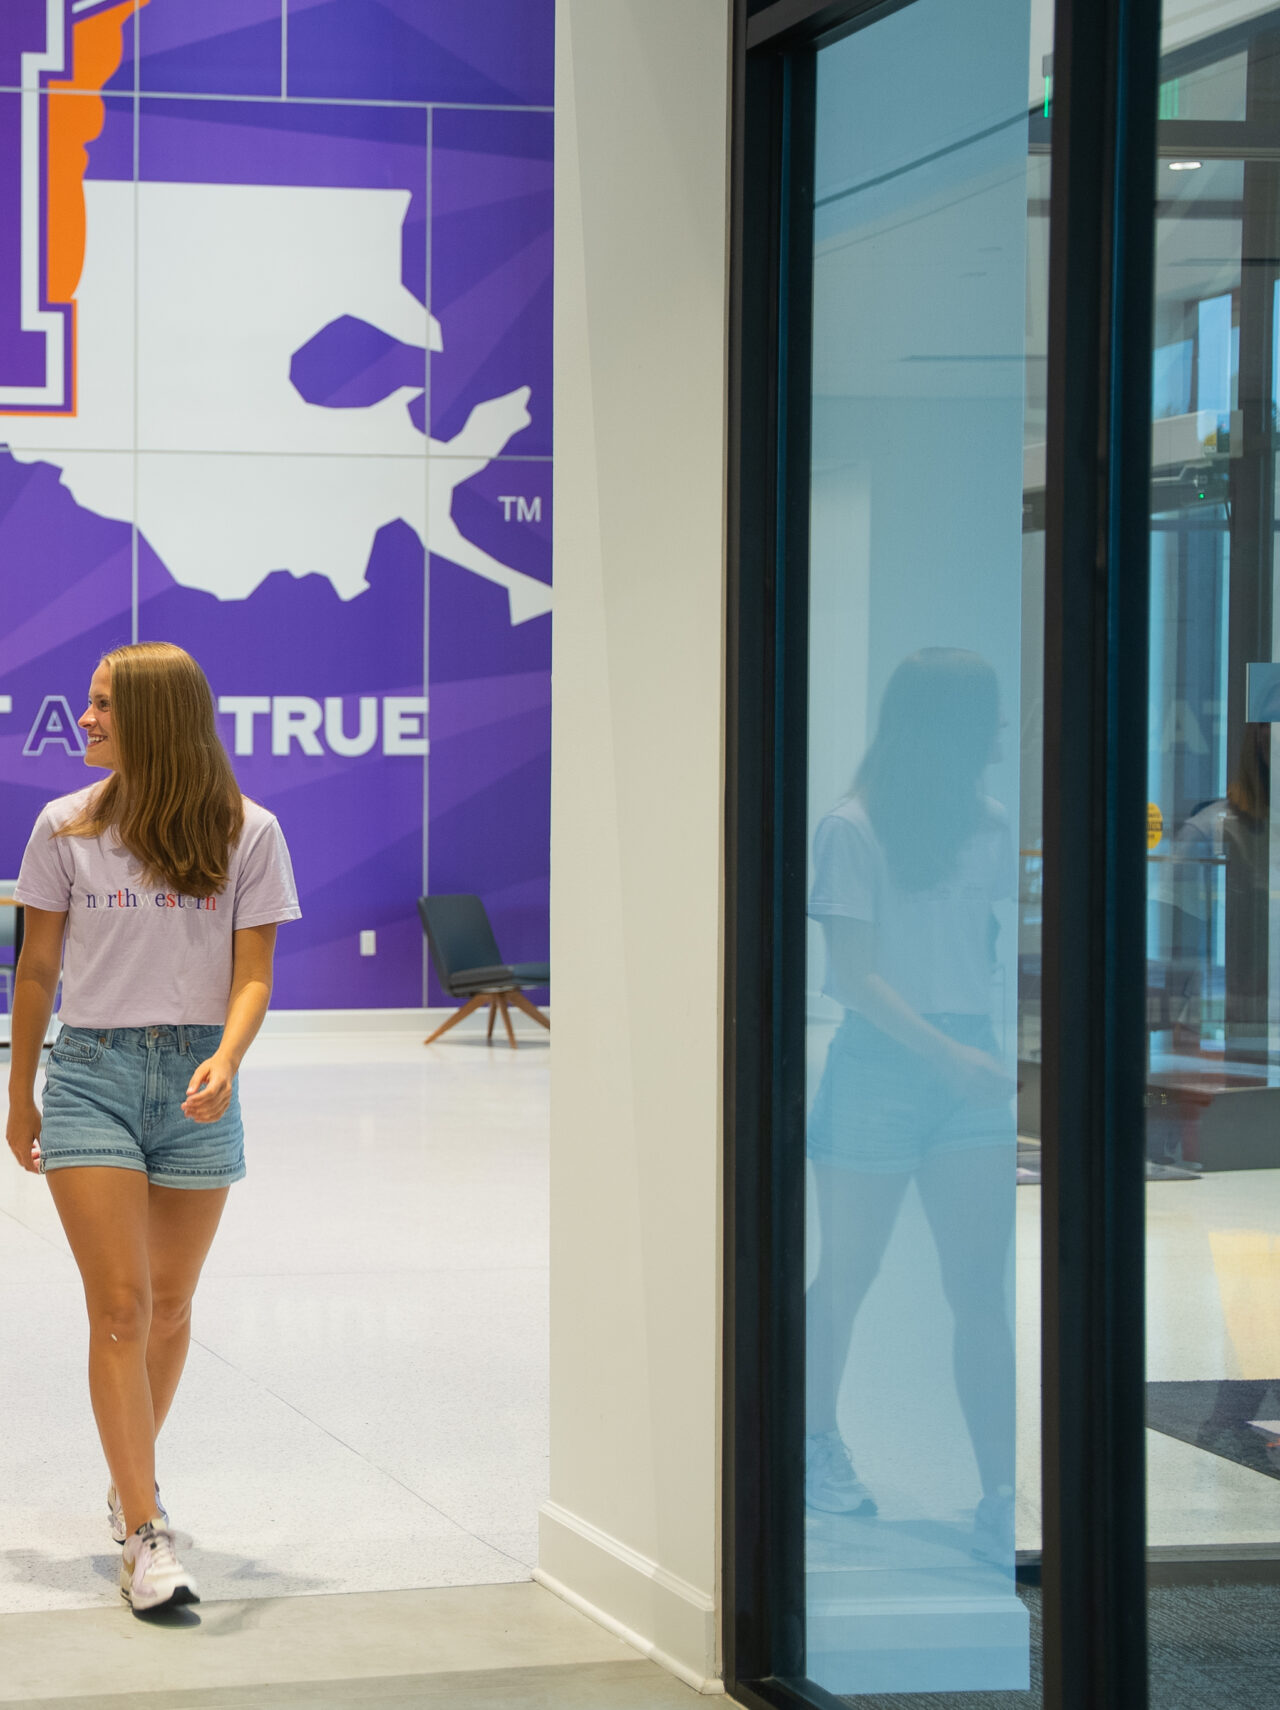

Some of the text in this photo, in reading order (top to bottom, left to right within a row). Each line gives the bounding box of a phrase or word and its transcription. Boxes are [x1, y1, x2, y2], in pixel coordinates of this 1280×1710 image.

[497, 495, 542, 523] TM
[219, 695, 430, 757] TRUE
[86, 887, 217, 911] northwestern
